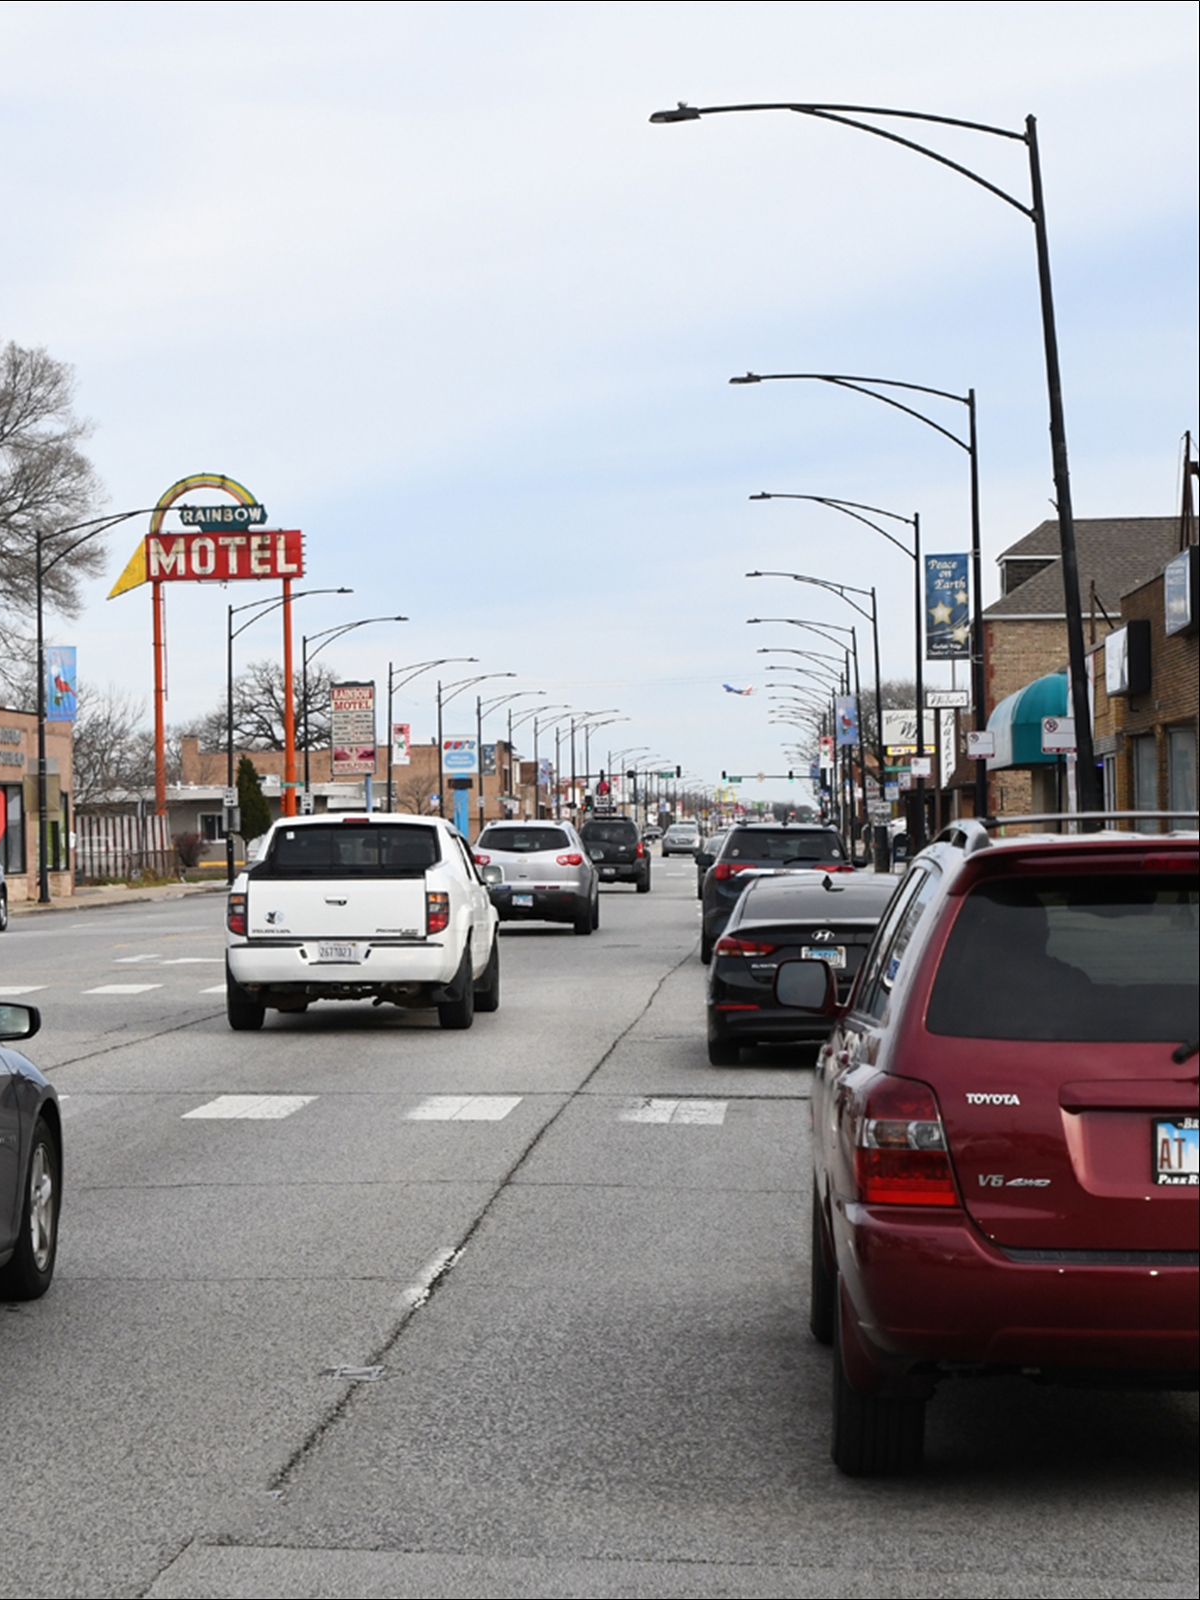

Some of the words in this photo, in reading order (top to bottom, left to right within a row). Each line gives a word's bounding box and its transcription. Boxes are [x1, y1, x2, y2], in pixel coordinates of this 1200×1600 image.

[183, 507, 263, 523] RAINBOW
[150, 534, 299, 577] MOTEL
[928, 559, 958, 569] Peace
[938, 570, 952, 578] on
[934, 576, 967, 589] Earth
[334, 701, 371, 711] MOTEL
[966, 1093, 1020, 1105] TOYOTA
[1183, 1117, 1199, 1129] BR
[1160, 1138, 1186, 1169] AT
[978, 1174, 1004, 1187] V6
[1005, 1178, 1051, 1187] 4WD
[1187, 1174, 1199, 1185] R
